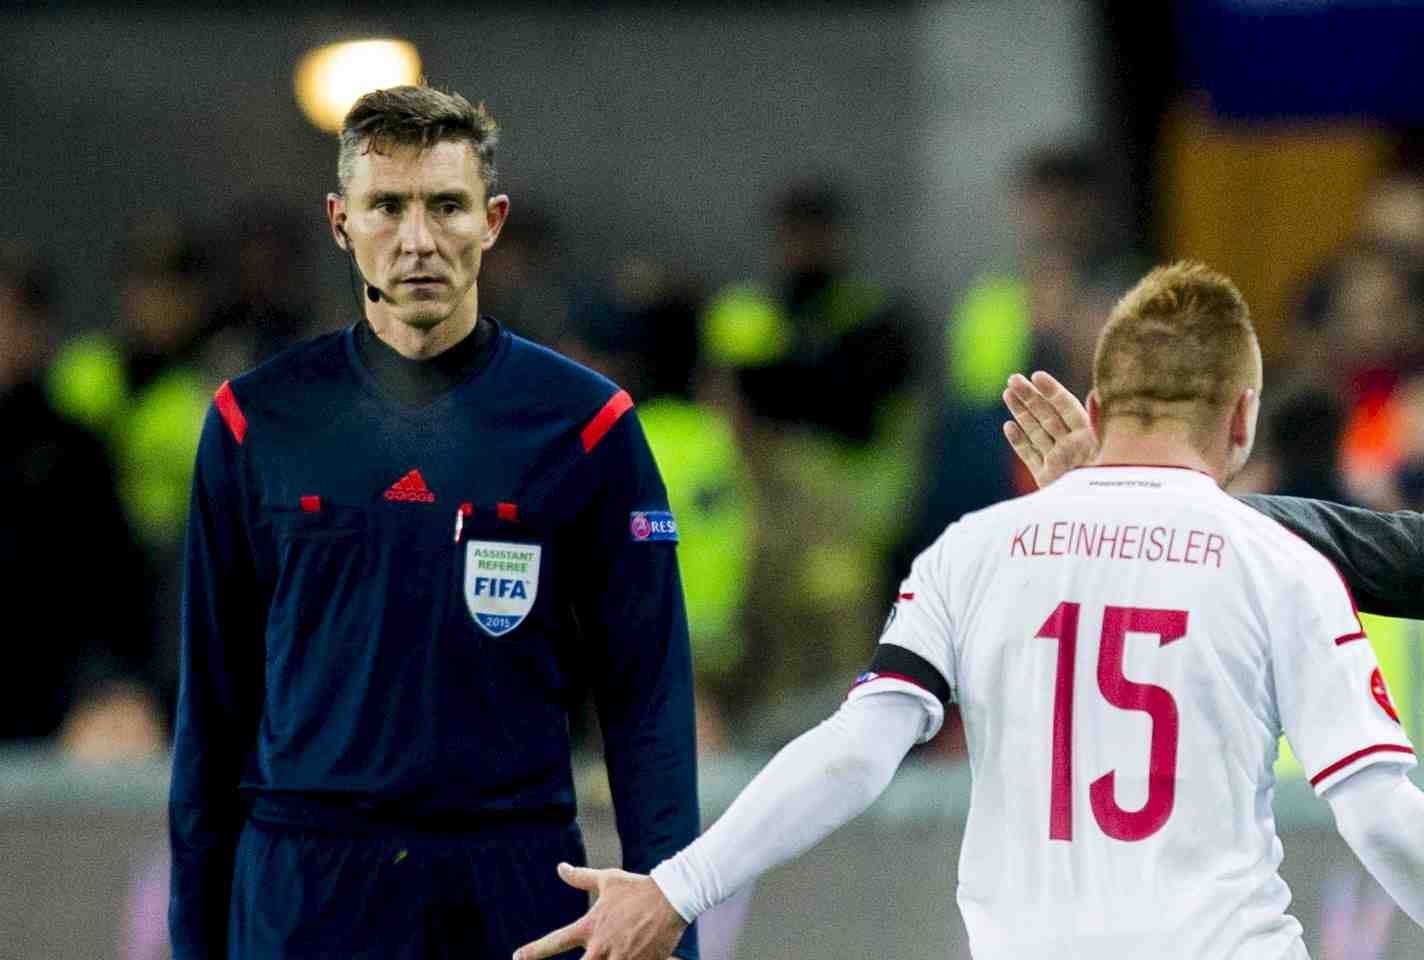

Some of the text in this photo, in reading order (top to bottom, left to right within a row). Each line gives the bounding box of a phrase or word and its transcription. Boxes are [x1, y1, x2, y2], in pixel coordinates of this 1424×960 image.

[1010, 521, 1225, 568] KLEINHEISLER
[474, 548, 535, 561] ASSISTANT
[478, 560, 529, 573] REFEREE
[475, 576, 527, 599] FIFA
[486, 616, 511, 628] 2015
[1034, 600, 1189, 842] 15
